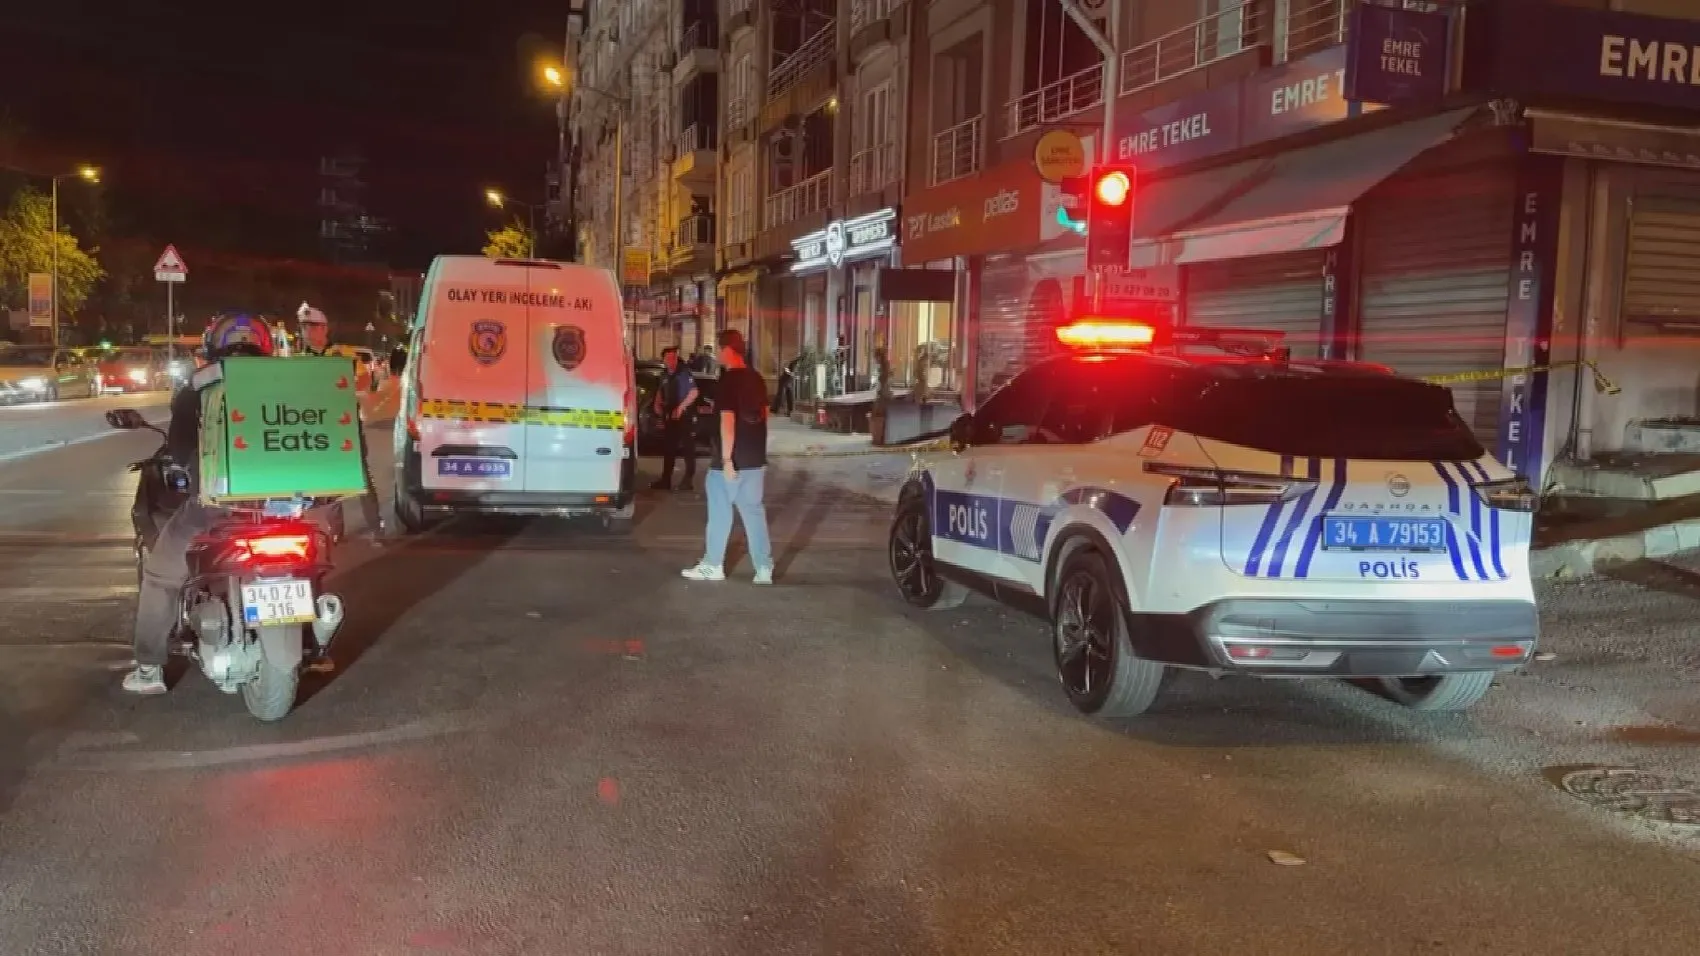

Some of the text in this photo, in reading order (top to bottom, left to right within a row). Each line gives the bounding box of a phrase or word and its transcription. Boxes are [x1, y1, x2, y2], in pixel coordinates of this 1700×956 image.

[1383, 38, 1421, 58] EMRE
[1380, 56, 1422, 76] TEKEL
[1271, 74, 1329, 115] EMRE
[1119, 112, 1211, 160] EMRE TEKEL
[1517, 192, 1538, 300] EMRE
[1324, 250, 1337, 316] MRE
[447, 288, 477, 302] OLAY
[261, 404, 327, 425] Uber
[262, 430, 329, 452] Eats
[464, 462, 473, 472] A
[949, 500, 988, 540] POLİS
[1334, 521, 1441, 545] 34 A 79153
[1359, 557, 1420, 578] POLİS
[267, 602, 295, 618] 316
